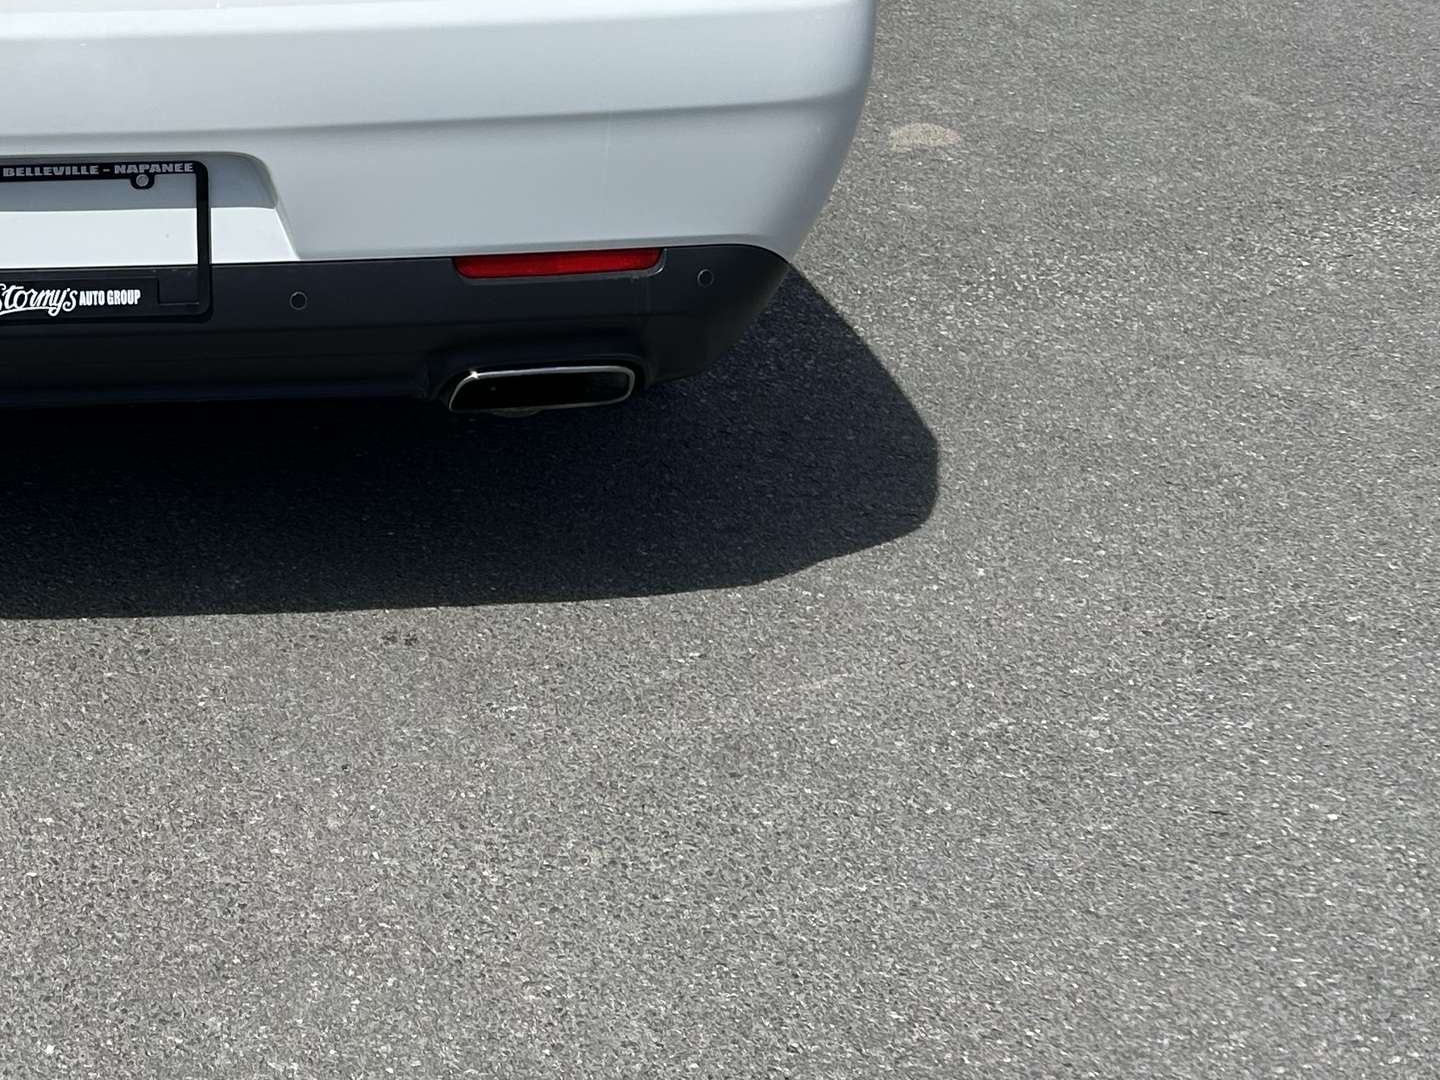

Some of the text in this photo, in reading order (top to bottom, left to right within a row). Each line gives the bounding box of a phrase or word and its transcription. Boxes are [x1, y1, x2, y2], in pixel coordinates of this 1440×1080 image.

[3, 164, 99, 177] BELLEVILLE
[114, 162, 194, 174] NAPANEE
[79, 291, 105, 306] AUTO
[107, 289, 142, 305] GROUP
